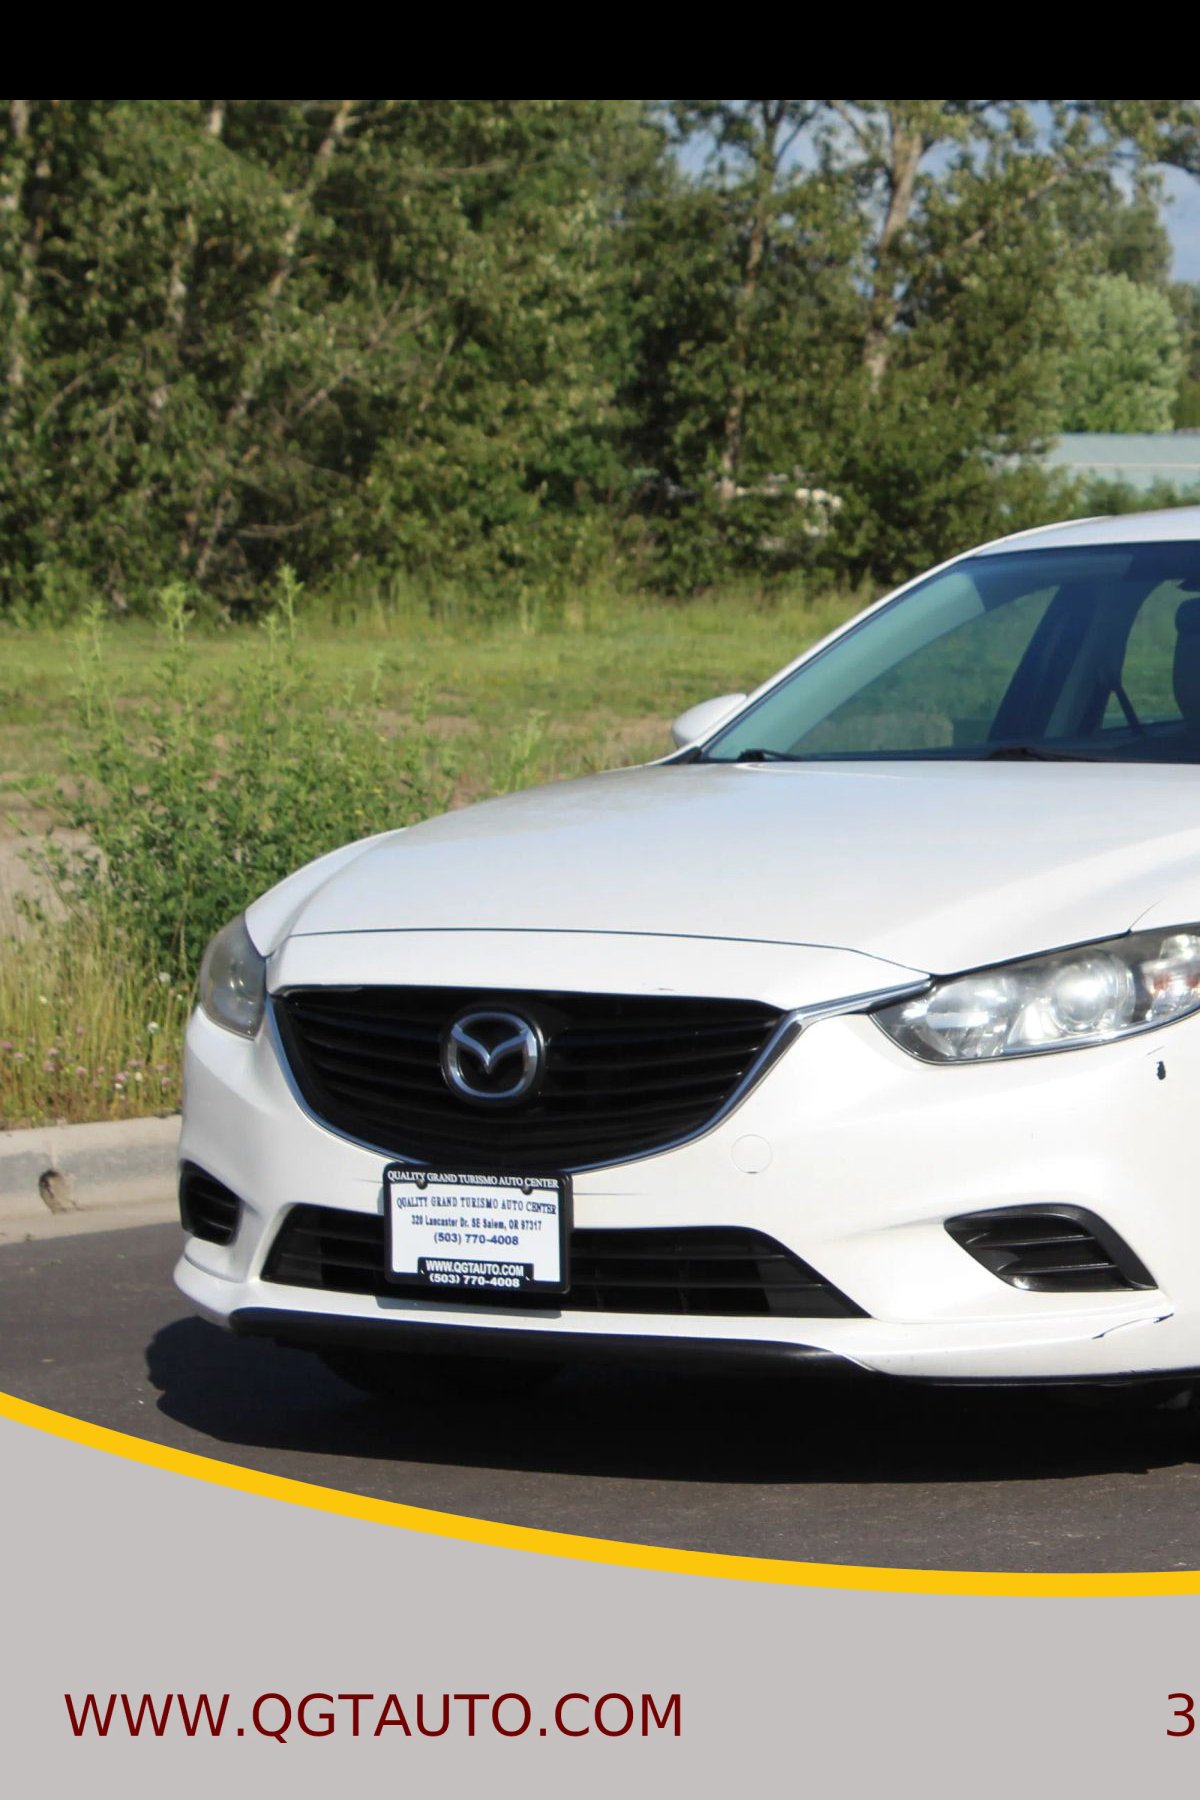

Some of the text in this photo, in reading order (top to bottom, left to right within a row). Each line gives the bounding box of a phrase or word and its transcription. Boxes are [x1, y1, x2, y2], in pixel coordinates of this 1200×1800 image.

[387, 1170, 559, 1188] QUALITY GRAND TURISMO AUTO CENTER
[397, 1196, 556, 1214] QUALITY GRAND TURISMO AUTO CENTER
[411, 1214, 423, 1225] 320
[425, 1215, 458, 1227] Lancaster
[472, 1218, 480, 1228] SE
[483, 1218, 506, 1230] Salem,
[509, 1219, 519, 1229] OR
[521, 1220, 542, 1230] 97317
[434, 1232, 519, 1246] (503) 770-4008
[425, 1259, 524, 1276] WWW.QGTAUTO.COM
[429, 1273, 520, 1287] (503) 770-4008
